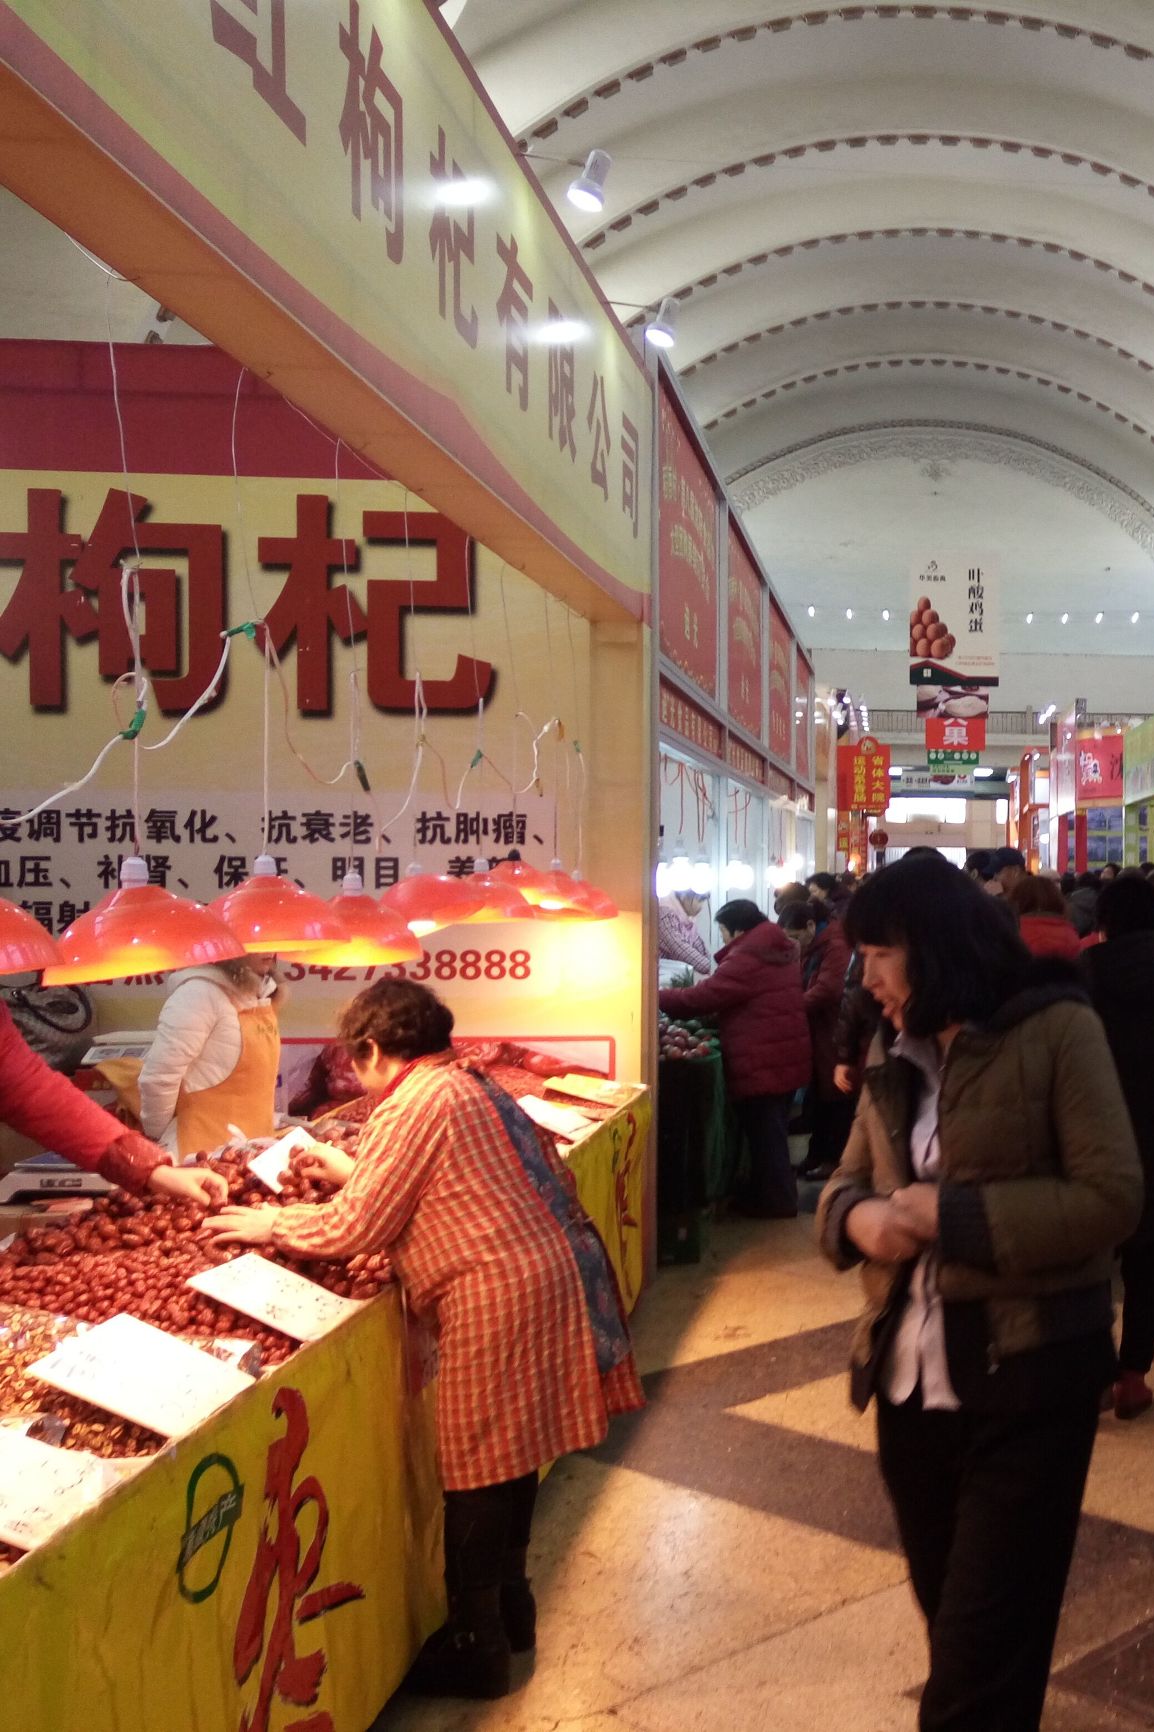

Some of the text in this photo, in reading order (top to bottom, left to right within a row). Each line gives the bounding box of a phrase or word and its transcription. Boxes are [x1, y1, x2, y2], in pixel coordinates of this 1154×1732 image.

[0, 487, 496, 716] 枸杞
[967, 567, 985, 634] 叶酸鸡蛋
